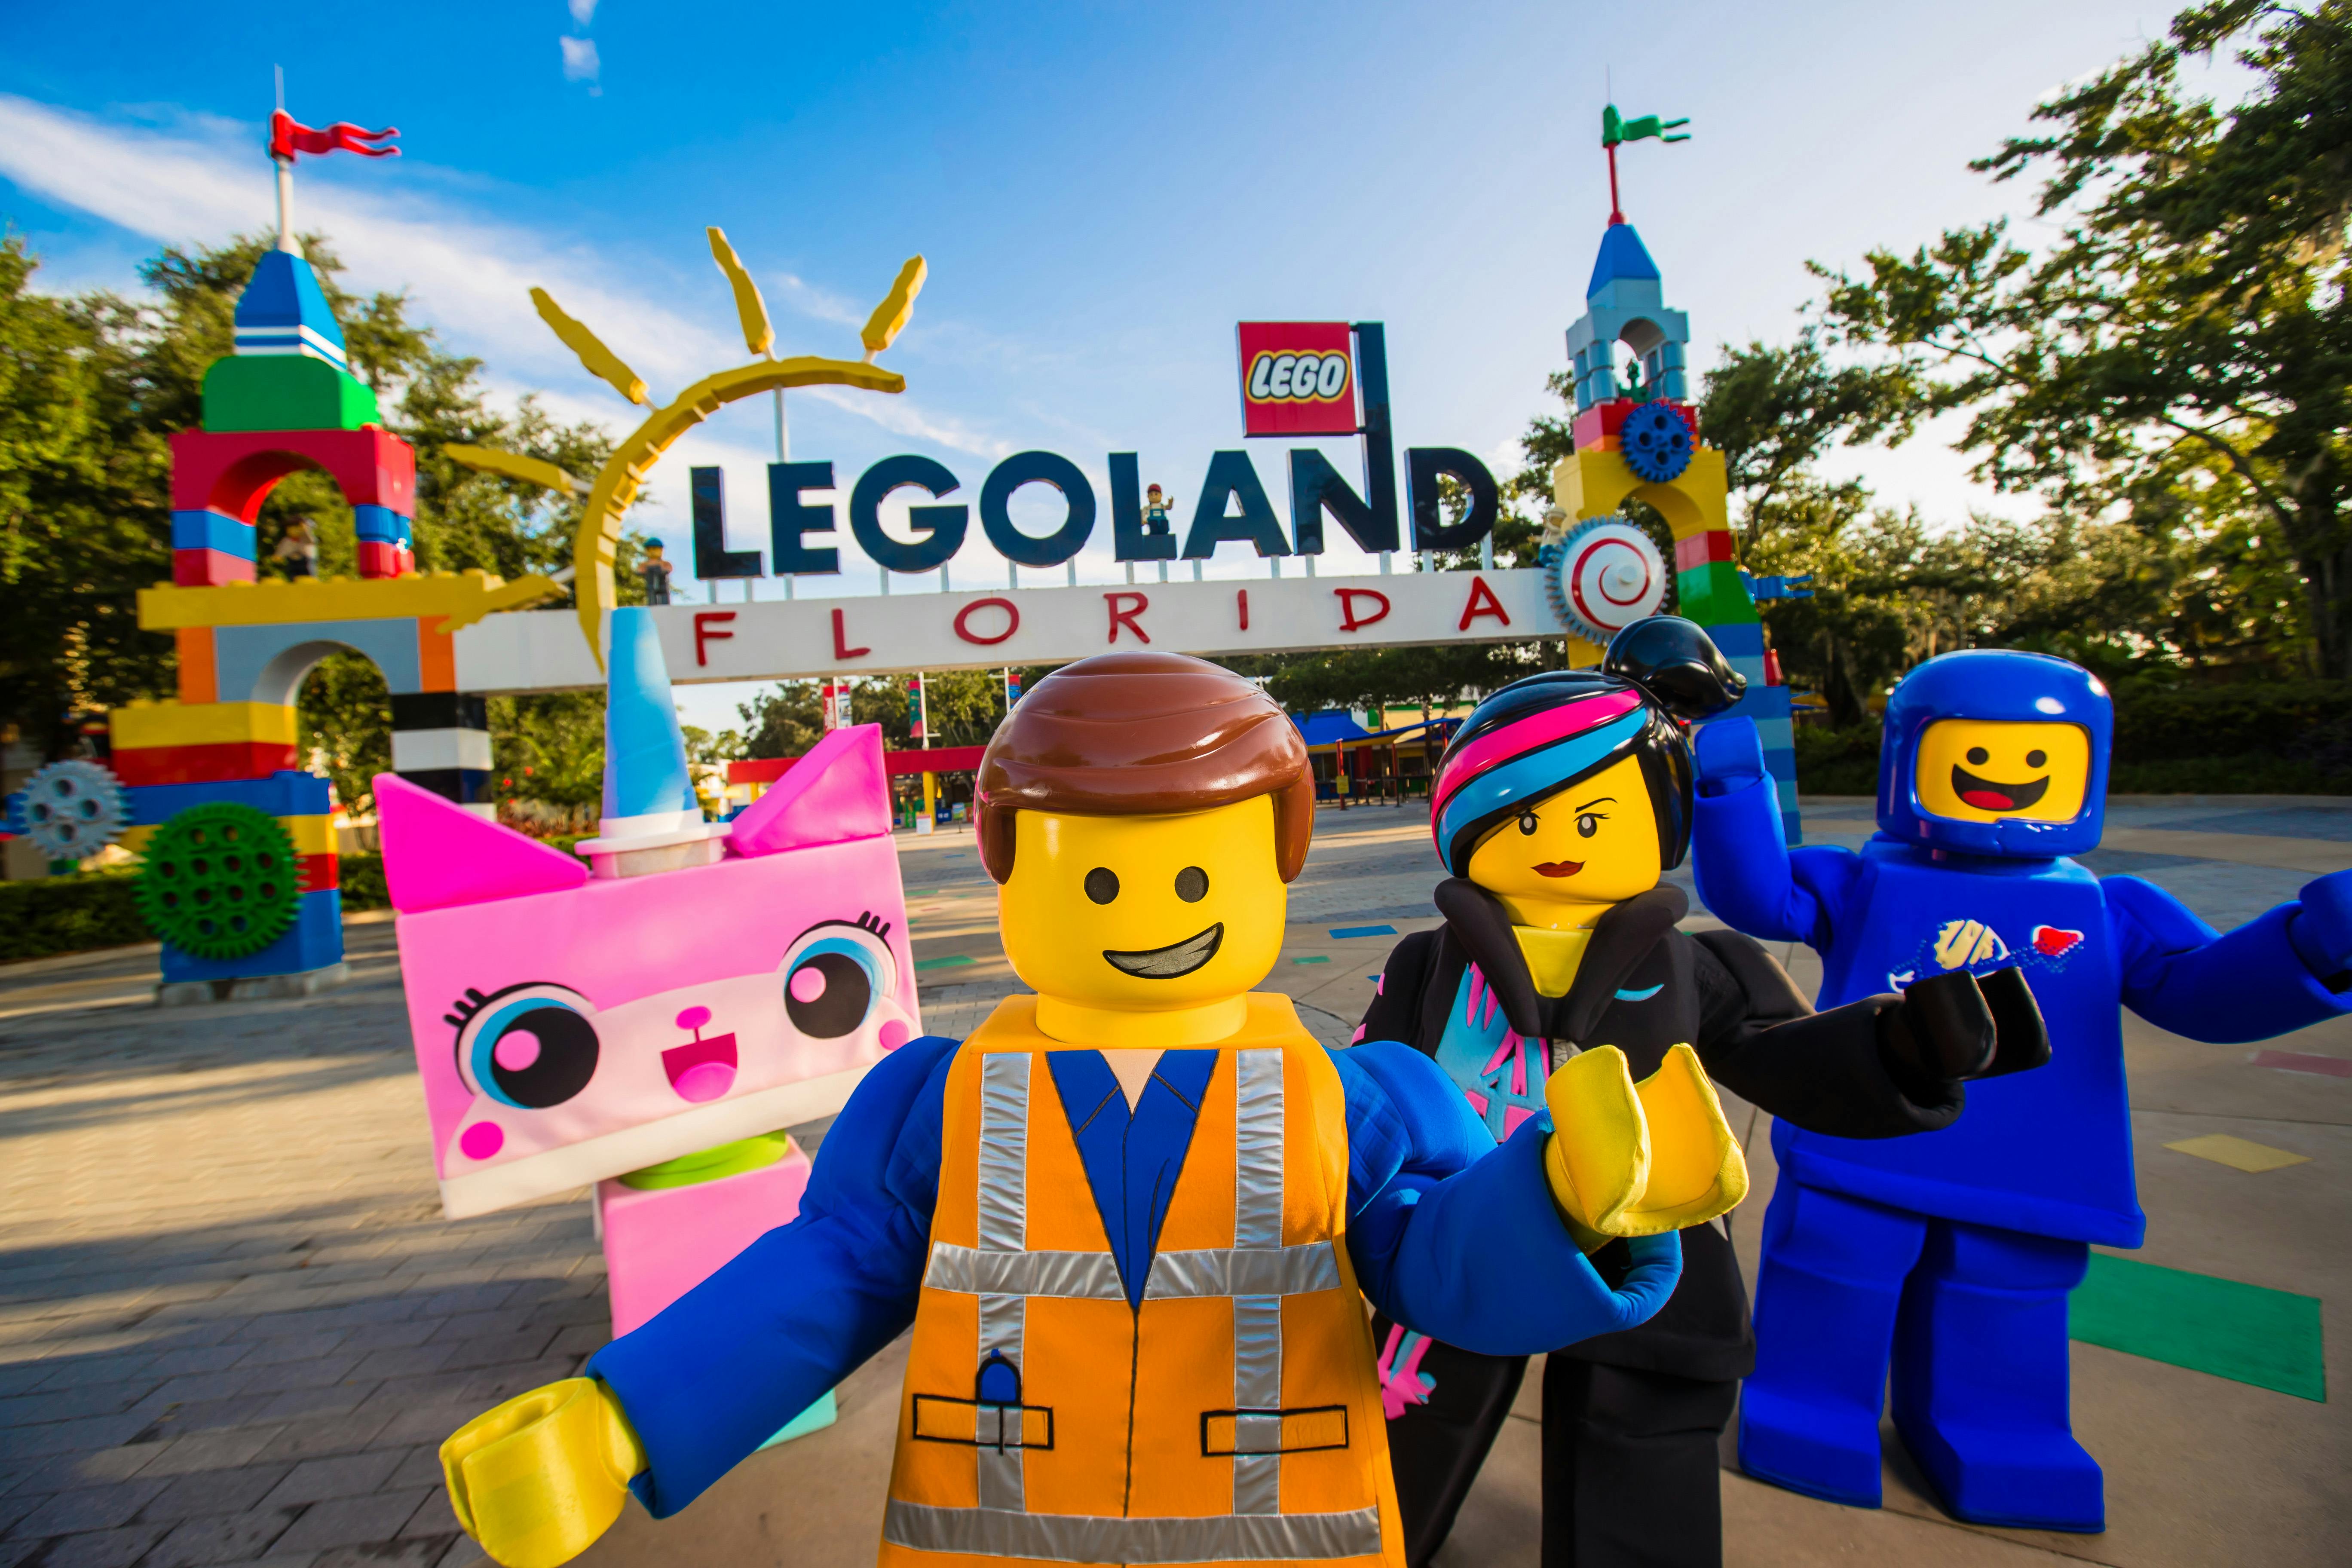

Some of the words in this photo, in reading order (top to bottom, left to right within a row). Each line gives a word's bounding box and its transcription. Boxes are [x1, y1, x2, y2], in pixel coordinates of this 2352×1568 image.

[1251, 355, 1346, 398] LEGO
[690, 321, 1499, 579] LEGOLAND
[695, 576, 1510, 666] FLORIDA
